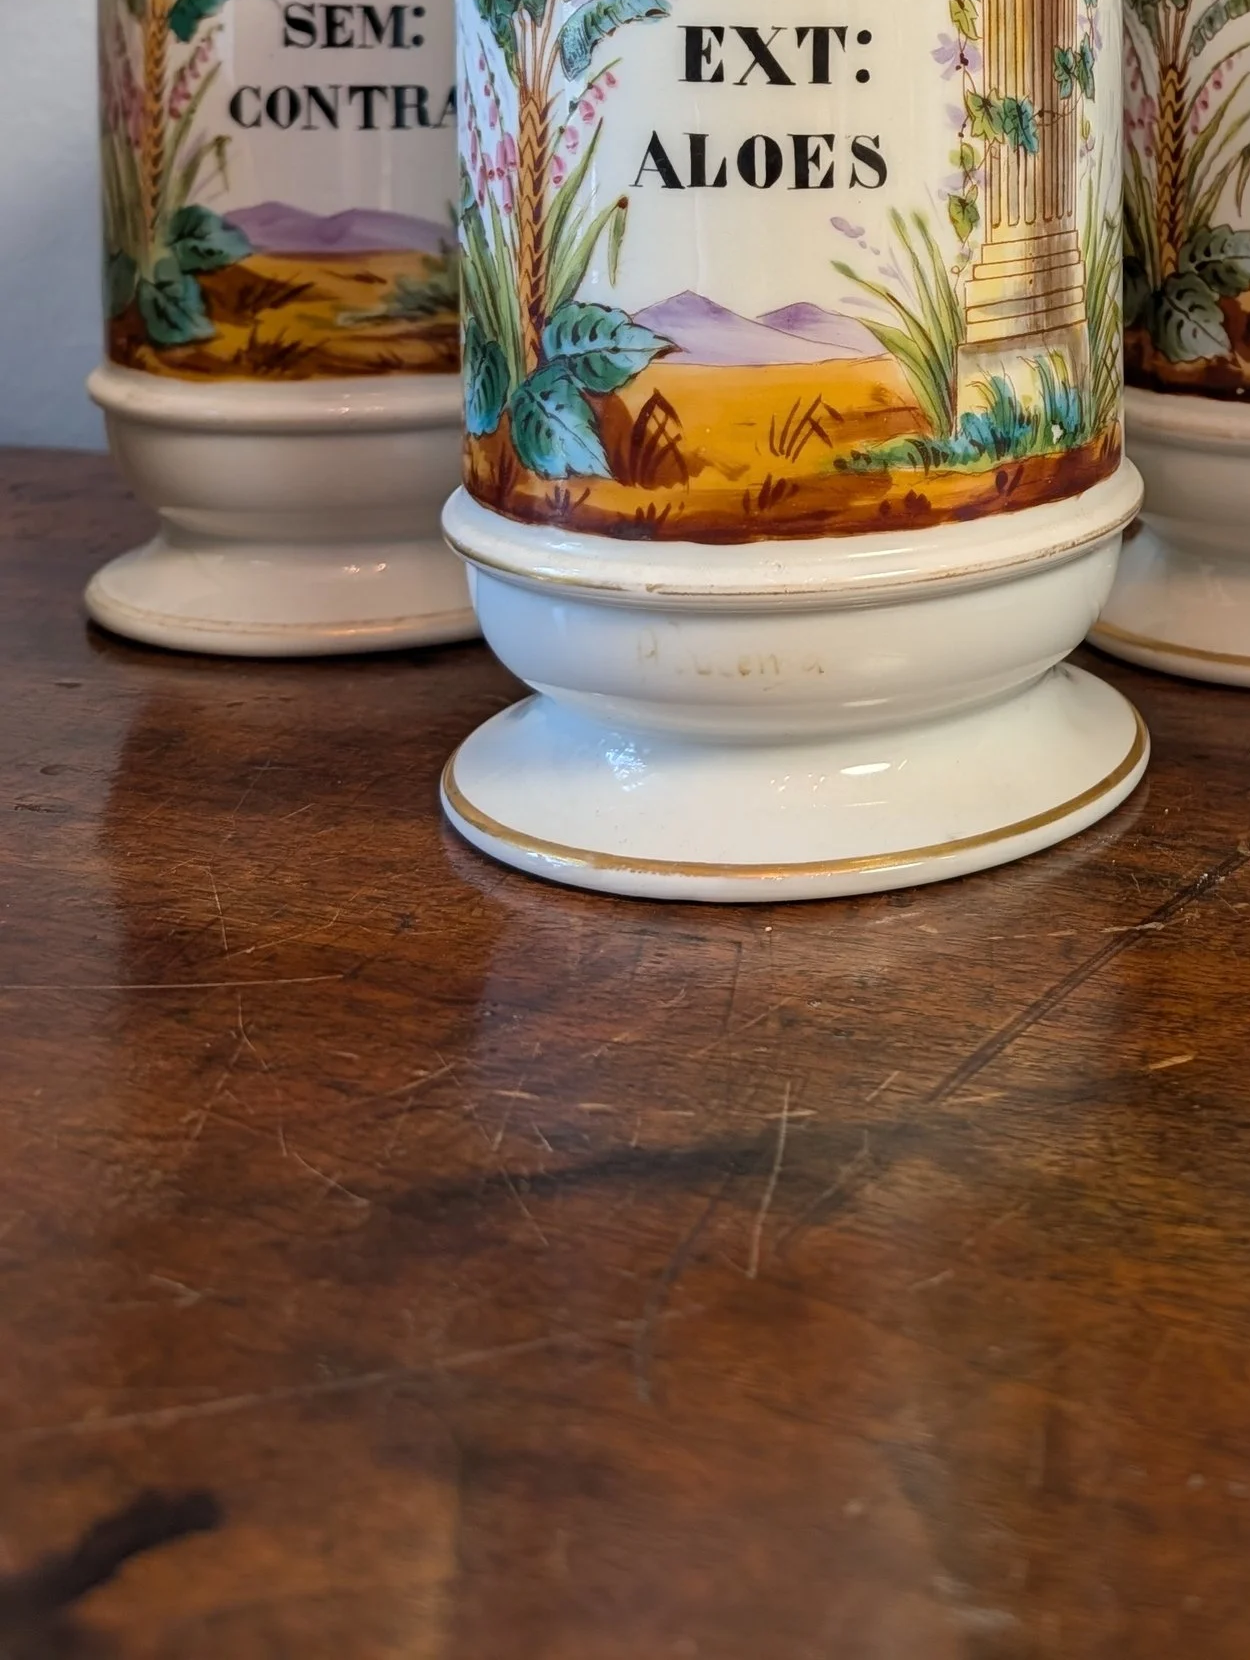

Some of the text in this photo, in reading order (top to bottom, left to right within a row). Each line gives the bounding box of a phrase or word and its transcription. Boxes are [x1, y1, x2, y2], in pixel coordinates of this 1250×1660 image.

[283, 2, 425, 49] SEM:
[677, 25, 872, 85] EXT:
[629, 130, 887, 189] ALOES
